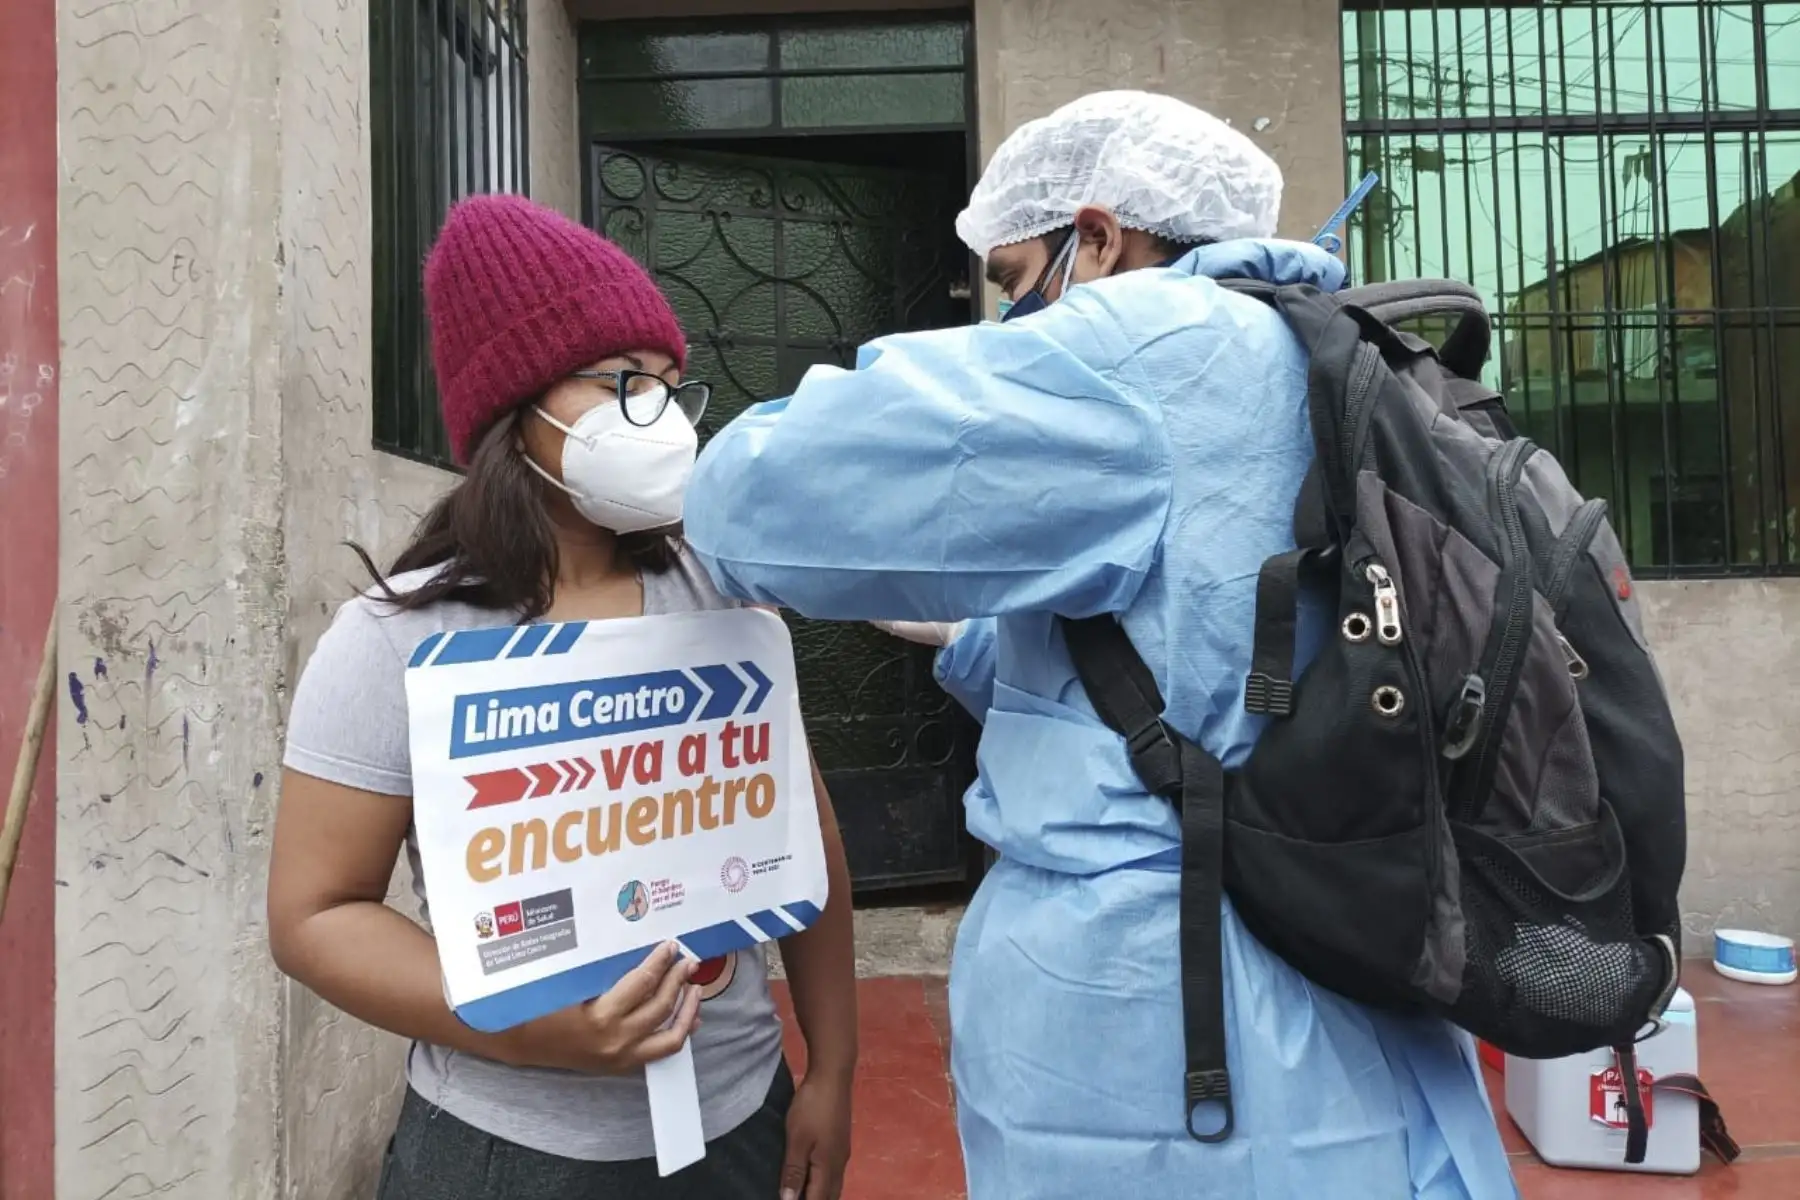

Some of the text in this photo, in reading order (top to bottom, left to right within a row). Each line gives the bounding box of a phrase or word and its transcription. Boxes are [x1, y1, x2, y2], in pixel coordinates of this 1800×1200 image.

[464, 685, 685, 744] Lima Centro
[600, 720, 770, 791] va a tu
[465, 773, 776, 884] encuentro
[498, 910, 519, 926] PERÚ
